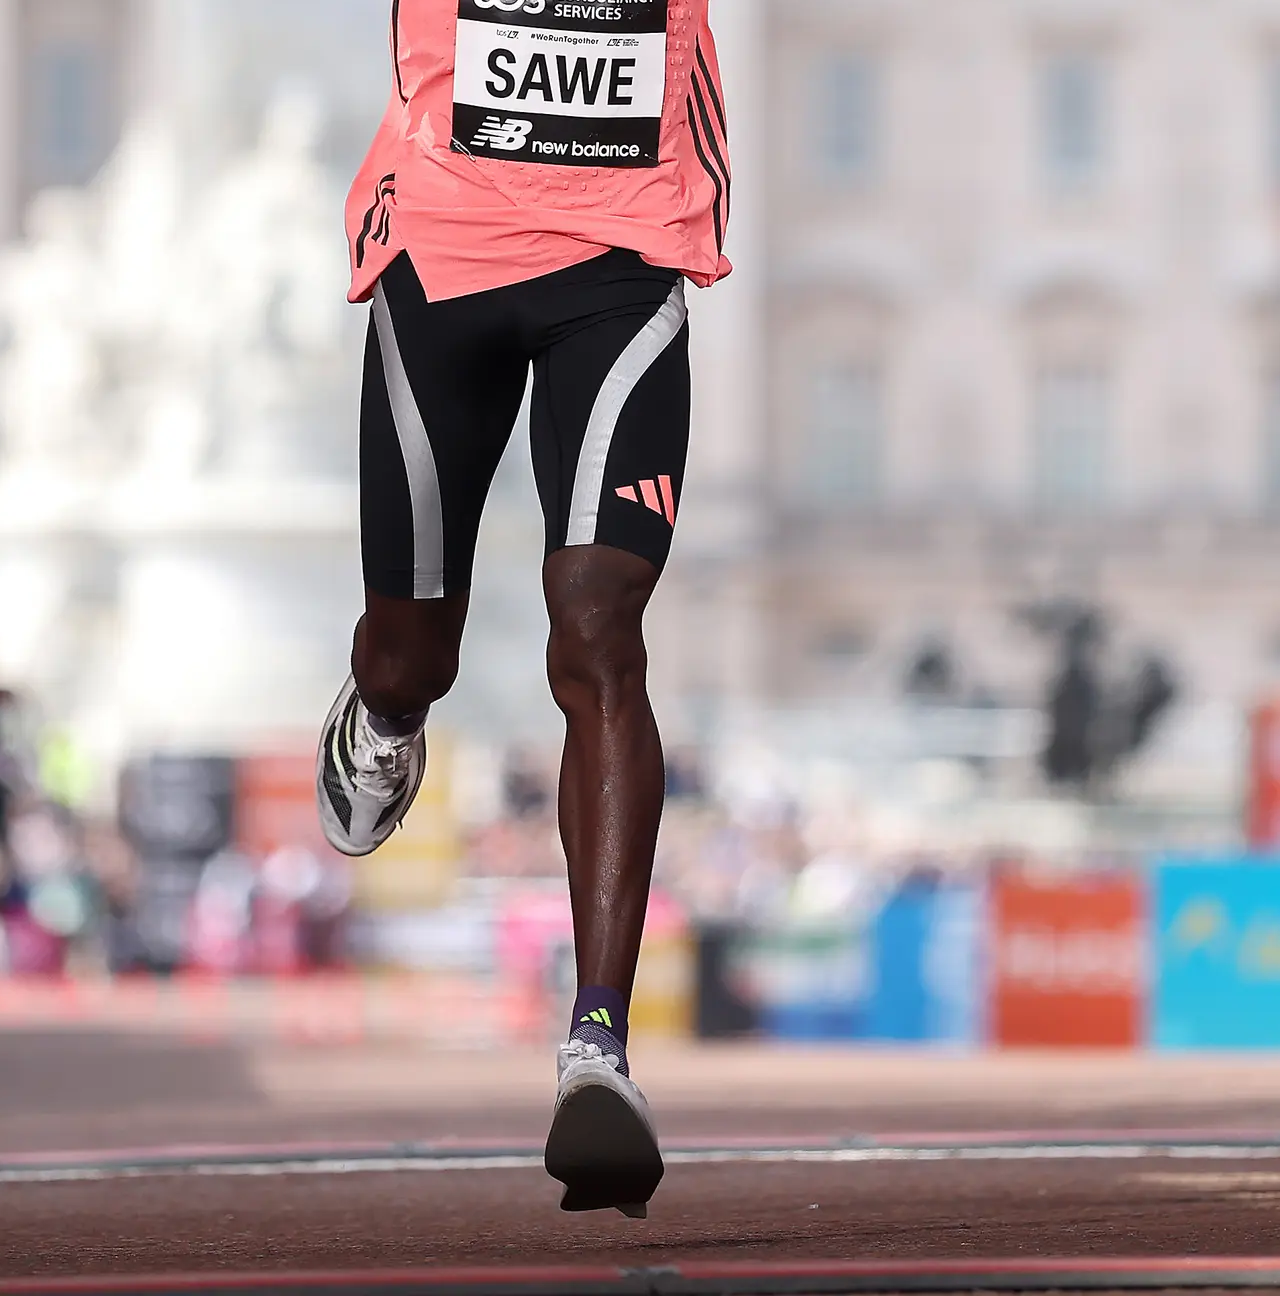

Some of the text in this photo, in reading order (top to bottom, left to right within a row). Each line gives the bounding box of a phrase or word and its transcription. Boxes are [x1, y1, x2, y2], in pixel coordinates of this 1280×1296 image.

[553, 4, 622, 20] SERVICES
[531, 33, 599, 45] #WeRunTogether
[485, 48, 636, 106] SAWE
[531, 140, 641, 158] new balance
